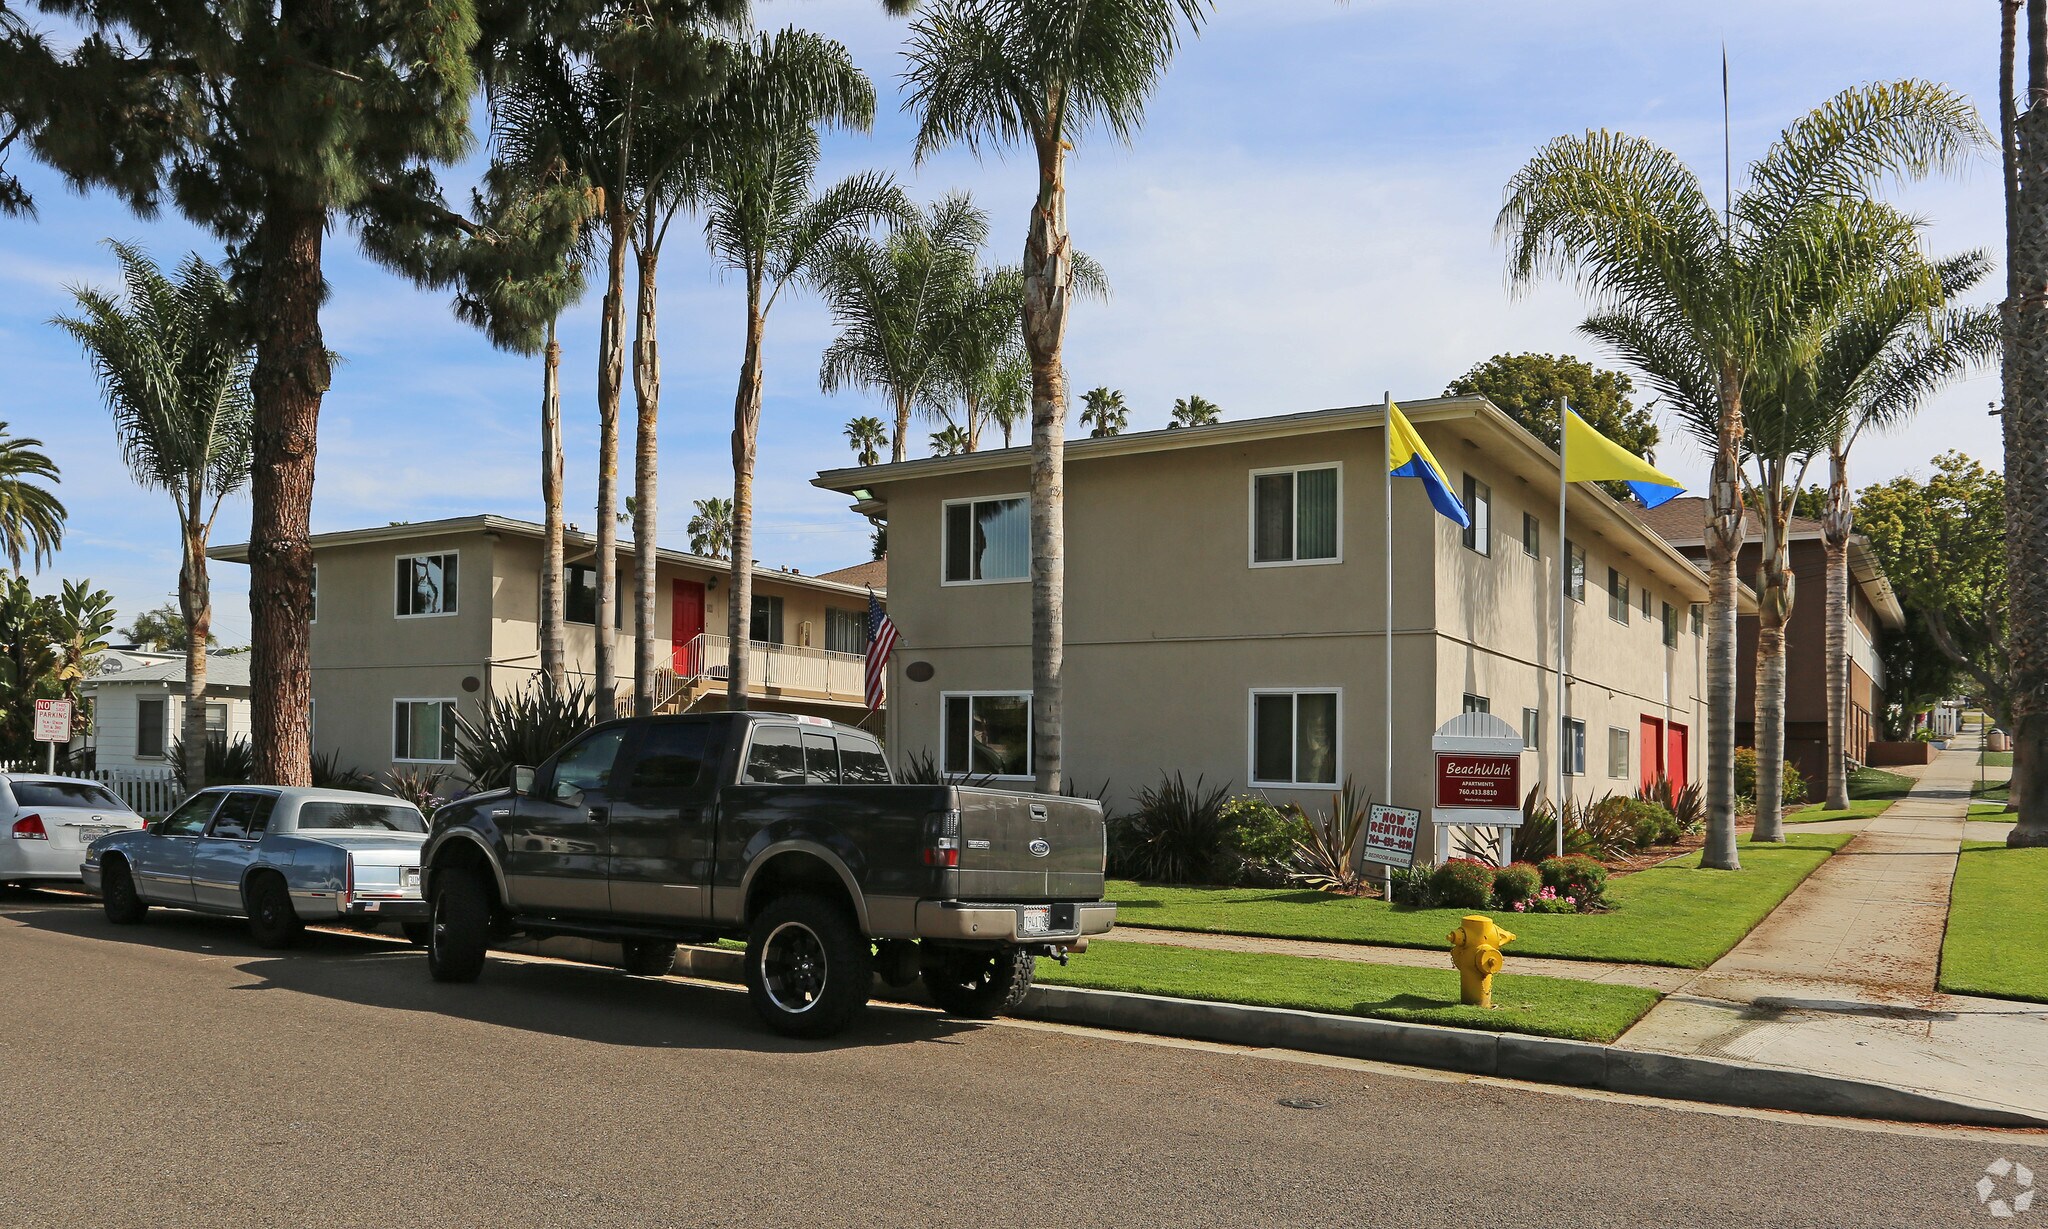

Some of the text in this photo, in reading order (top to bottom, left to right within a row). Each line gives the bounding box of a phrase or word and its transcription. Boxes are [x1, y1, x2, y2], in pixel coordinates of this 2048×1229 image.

[38, 701, 50, 710] NO
[39, 711, 67, 719] PARKING
[1446, 762, 1511, 776] BeachWalk
[1458, 788, 1498, 796] 760.433.8810
[1382, 811, 1406, 826] NOW
[1370, 821, 1414, 839] RENTING
